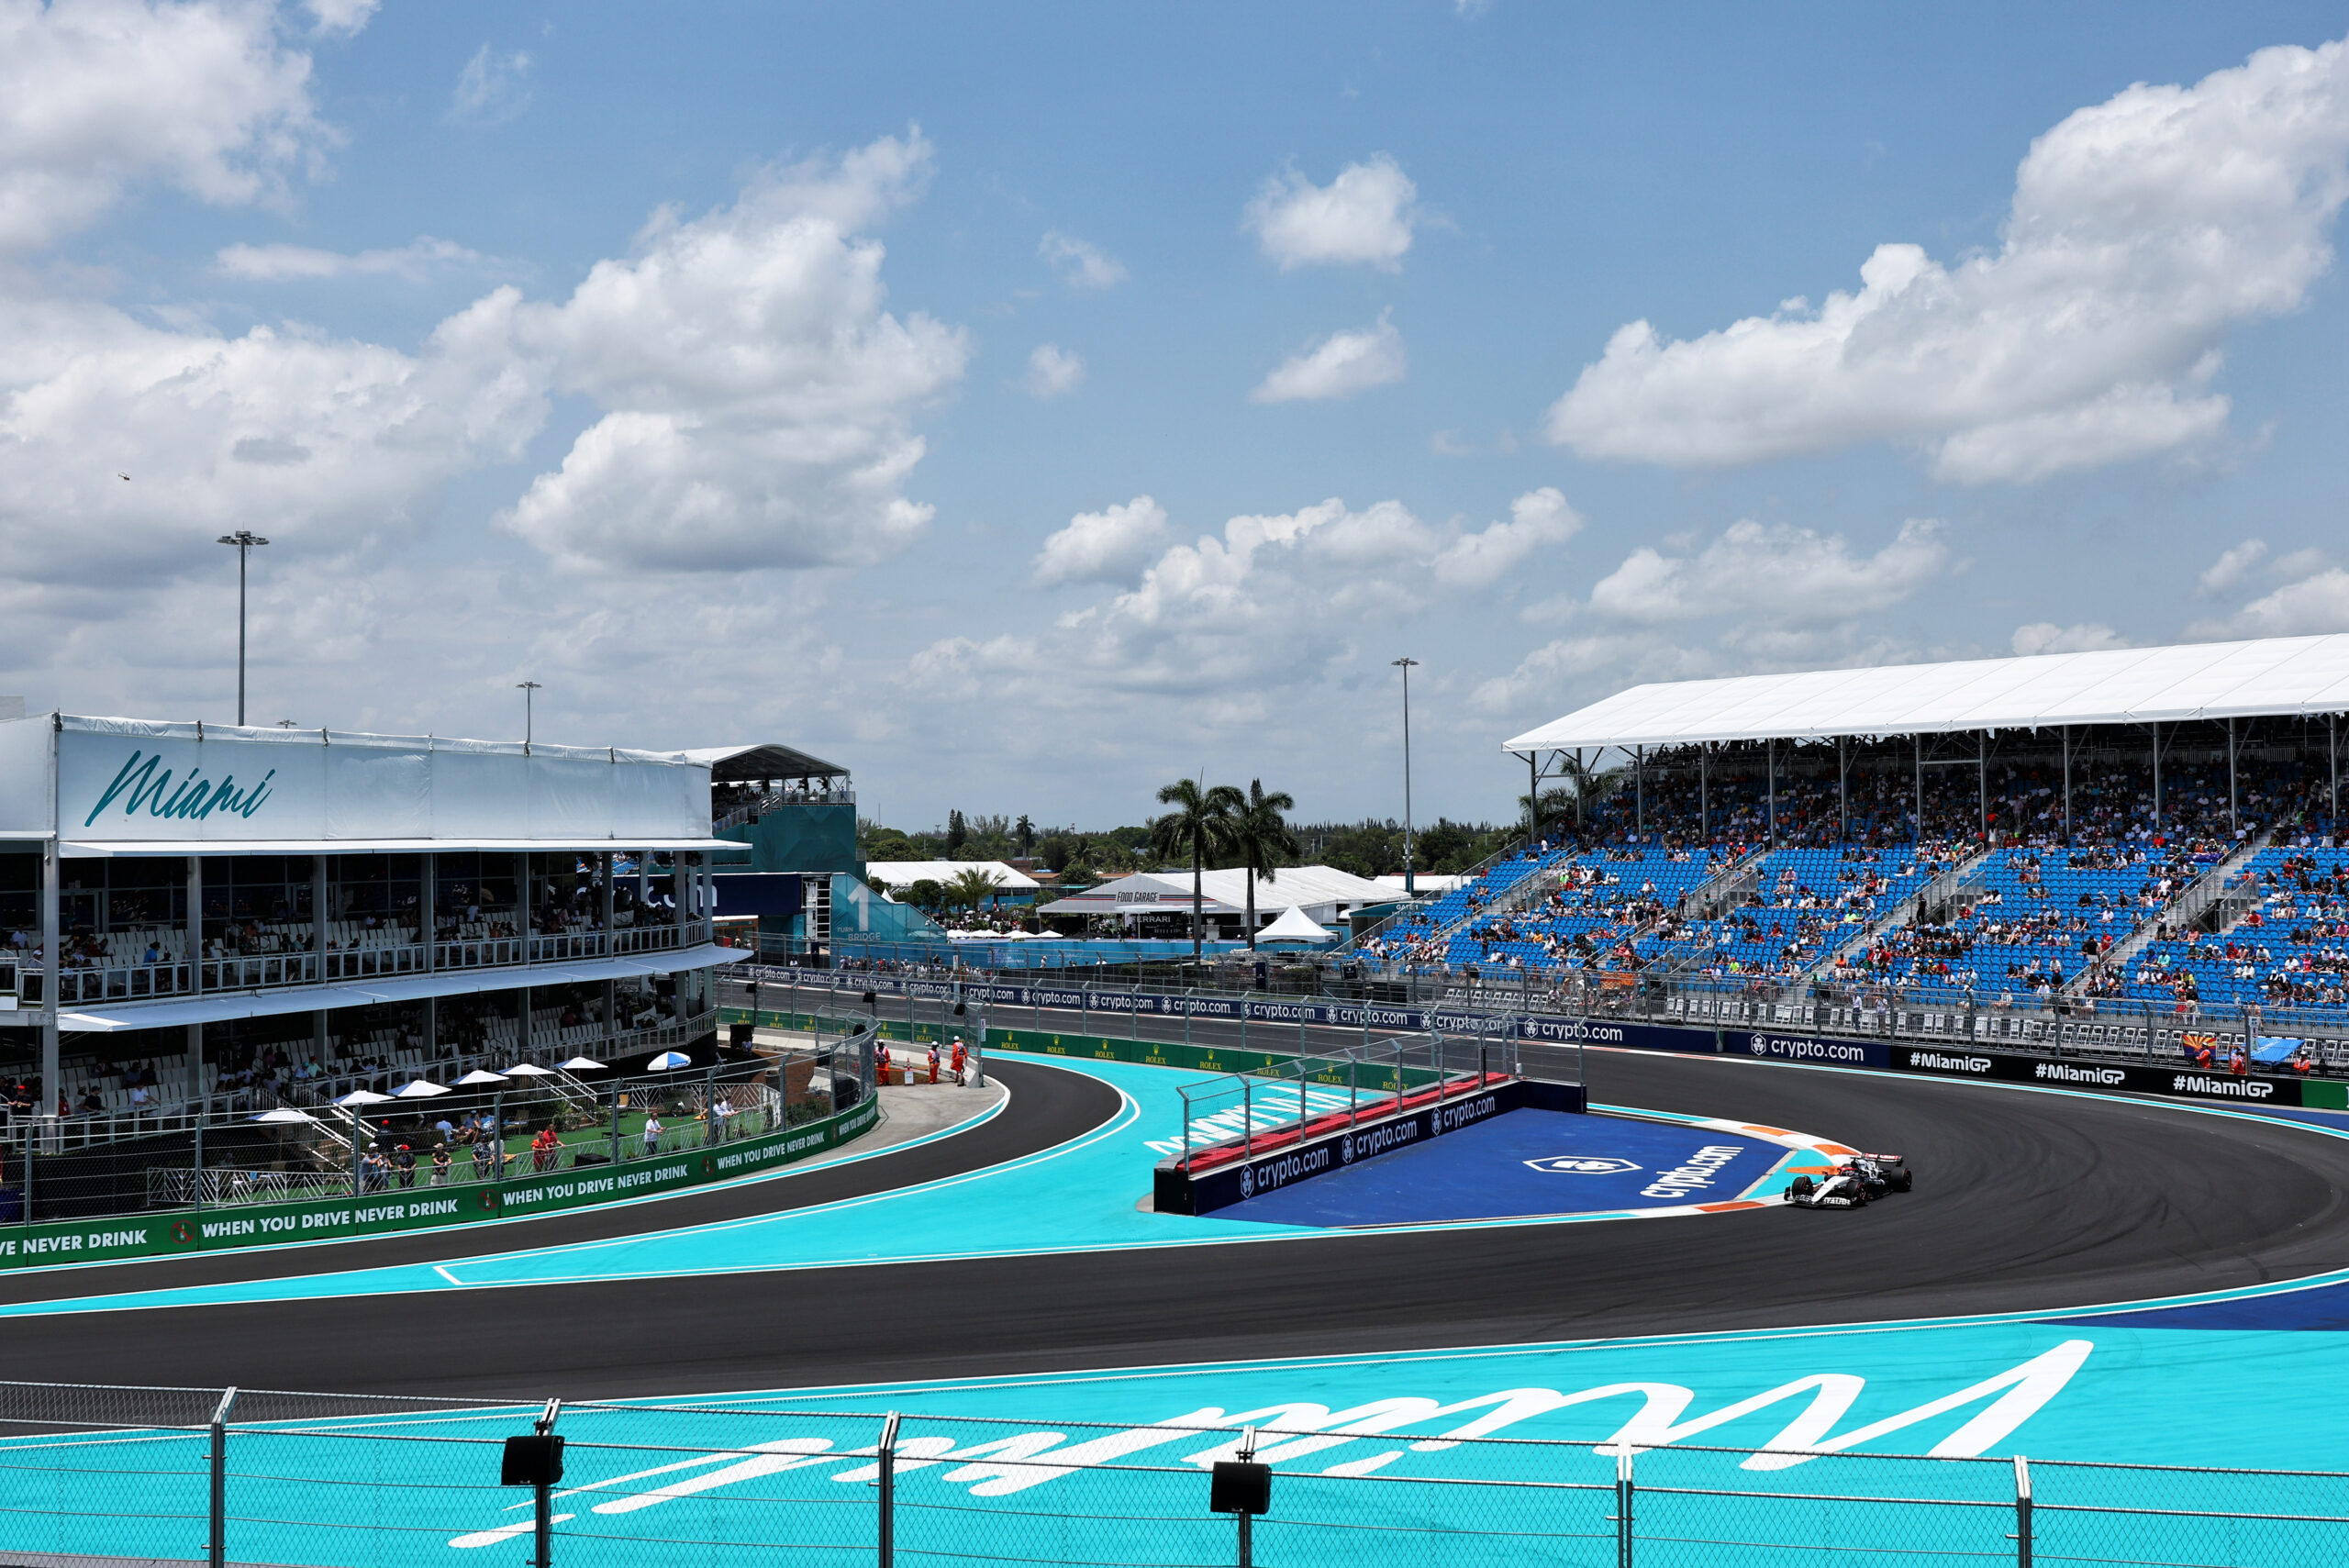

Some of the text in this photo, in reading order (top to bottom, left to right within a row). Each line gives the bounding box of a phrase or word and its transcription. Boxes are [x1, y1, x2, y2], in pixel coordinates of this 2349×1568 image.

[84, 750, 276, 828] Miami
[847, 883, 869, 931] 1
[1117, 891, 1159, 903] FOOD GARAGE
[848, 932, 881, 941] BRIDGE
[756, 968, 790, 980] crpto.com
[1101, 996, 1153, 1009] crypto.com
[1174, 1000, 1230, 1014] crpto.com
[1341, 1009, 1408, 1025] crypto.com
[1542, 1020, 1623, 1040] crypto.com
[1001, 1041, 1019, 1051] ROLEX
[1047, 1045, 1065, 1054] ROLEX
[1095, 1050, 1115, 1059] ROLEX
[1771, 1040, 1865, 1062] crypto.com
[1145, 1055, 1166, 1064] ROLEX
[1199, 1061, 1221, 1071] ROLEX
[1910, 1051, 1992, 1073] #MiamiGP
[1318, 1073, 1342, 1084] ROLEX
[2035, 1062, 2125, 1084] #MiamiGP
[1383, 1081, 1408, 1090] ROLX
[2173, 1074, 2274, 1098] #MiamiGP
[1443, 1095, 1496, 1129] crypto.com
[1356, 1119, 1418, 1155] crypto.com
[717, 1130, 825, 1170] WHEN YOU DRIVE NEVER DRINK
[1258, 1145, 1329, 1187] crypto.com
[1640, 1146, 1744, 1198] crypto.com
[503, 1163, 688, 1206] WHEN YOU DRIVE NEVER DRINK
[201, 1198, 459, 1239] WHEN YOU DRIVE NEVER DRINK
[23, 1234, 83, 1254] NEVER
[88, 1229, 148, 1248] DRINK
